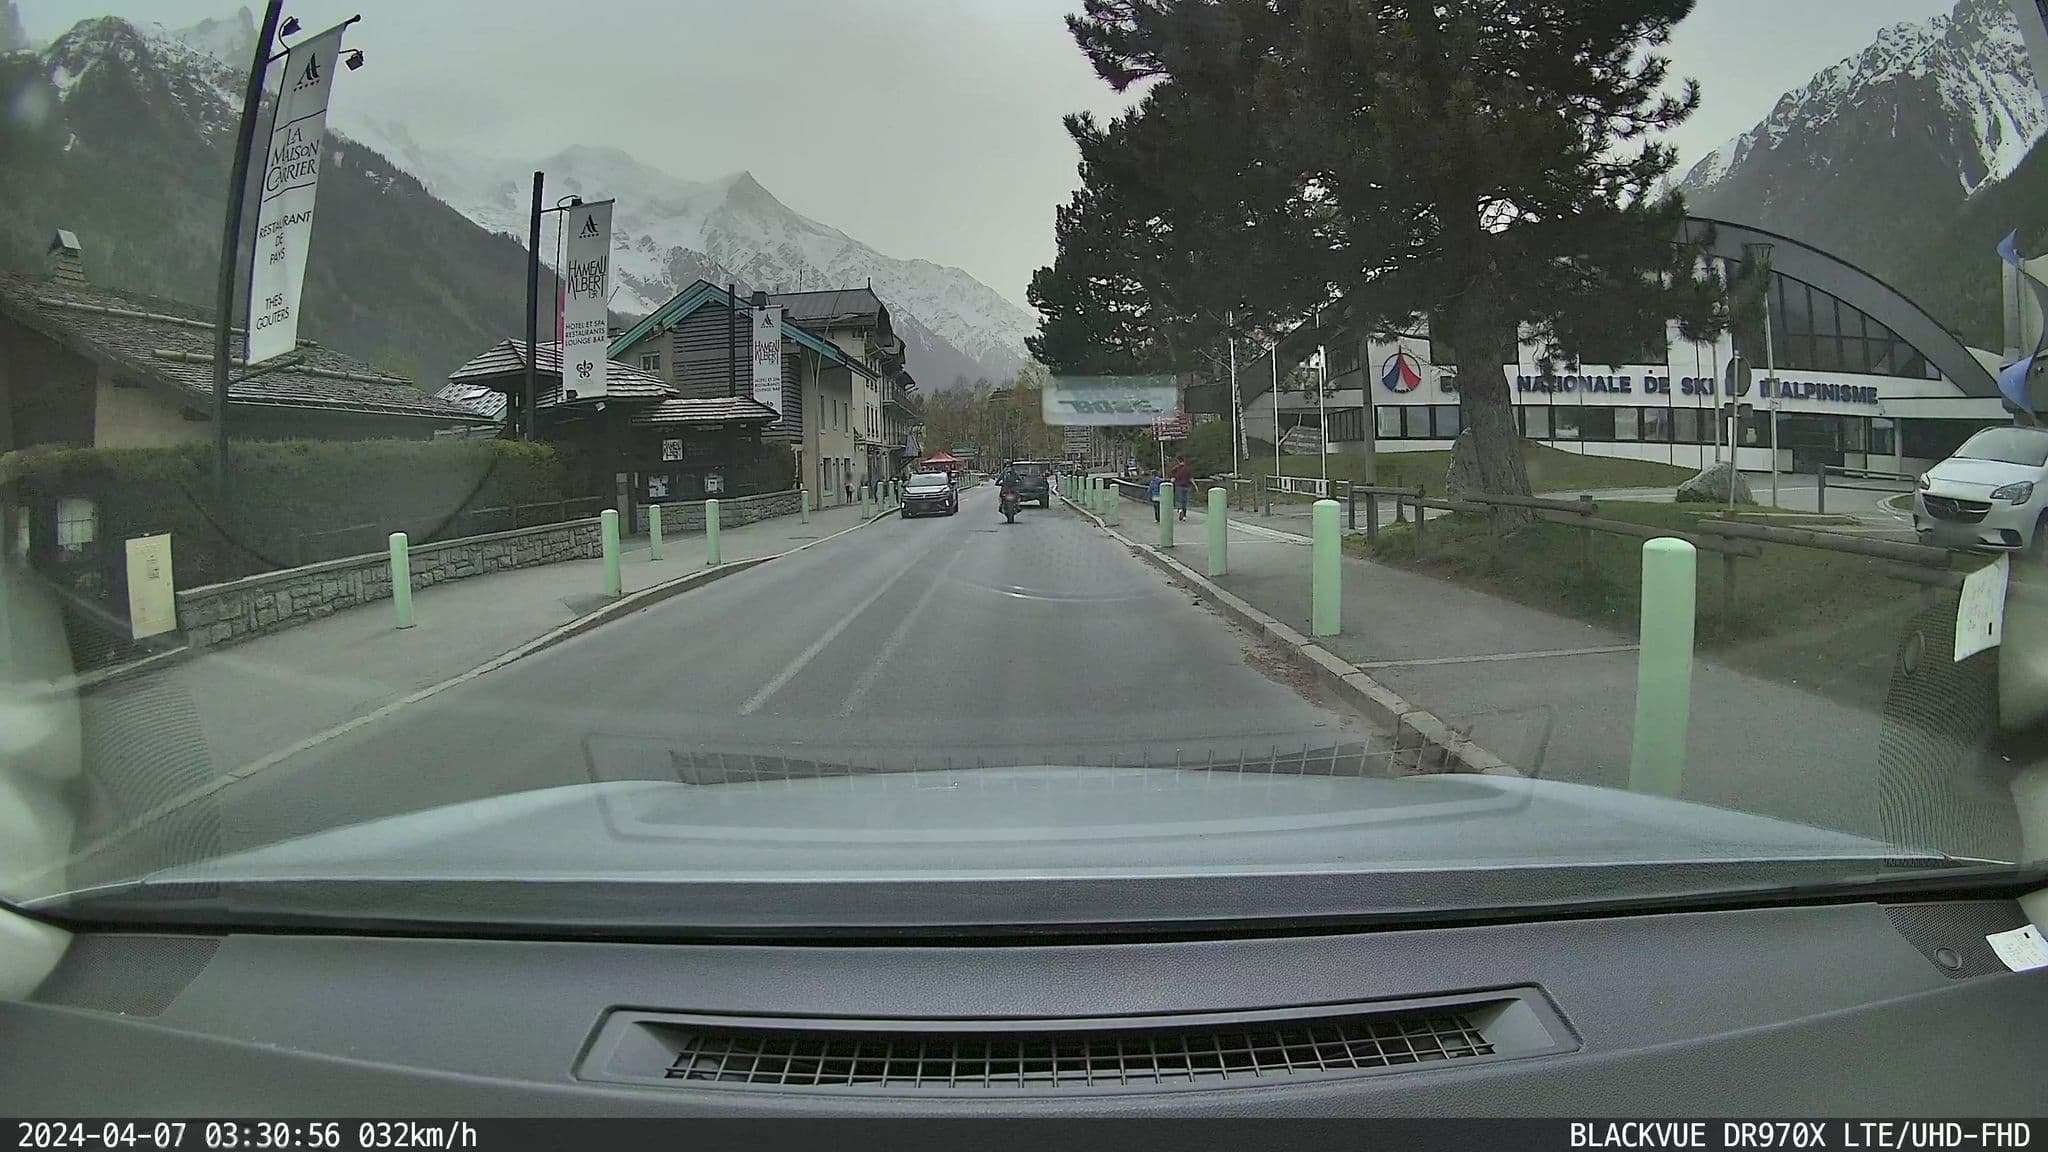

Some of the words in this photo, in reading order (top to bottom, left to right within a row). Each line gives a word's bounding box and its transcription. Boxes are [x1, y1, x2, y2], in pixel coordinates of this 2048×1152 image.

[287, 128, 302, 146] LA
[271, 139, 319, 167] MAISON
[267, 159, 316, 191] CARRIER
[259, 210, 312, 239] RESTAURANT
[275, 232, 284, 247] DE
[270, 247, 285, 265] PAYS
[568, 256, 607, 279] HAMEAU
[567, 274, 606, 300] ALBERT
[594, 319, 606, 327] SPA
[566, 336, 592, 347] LOUNGE
[1644, 376, 1670, 394] DE
[1681, 377, 1715, 396] SKI
